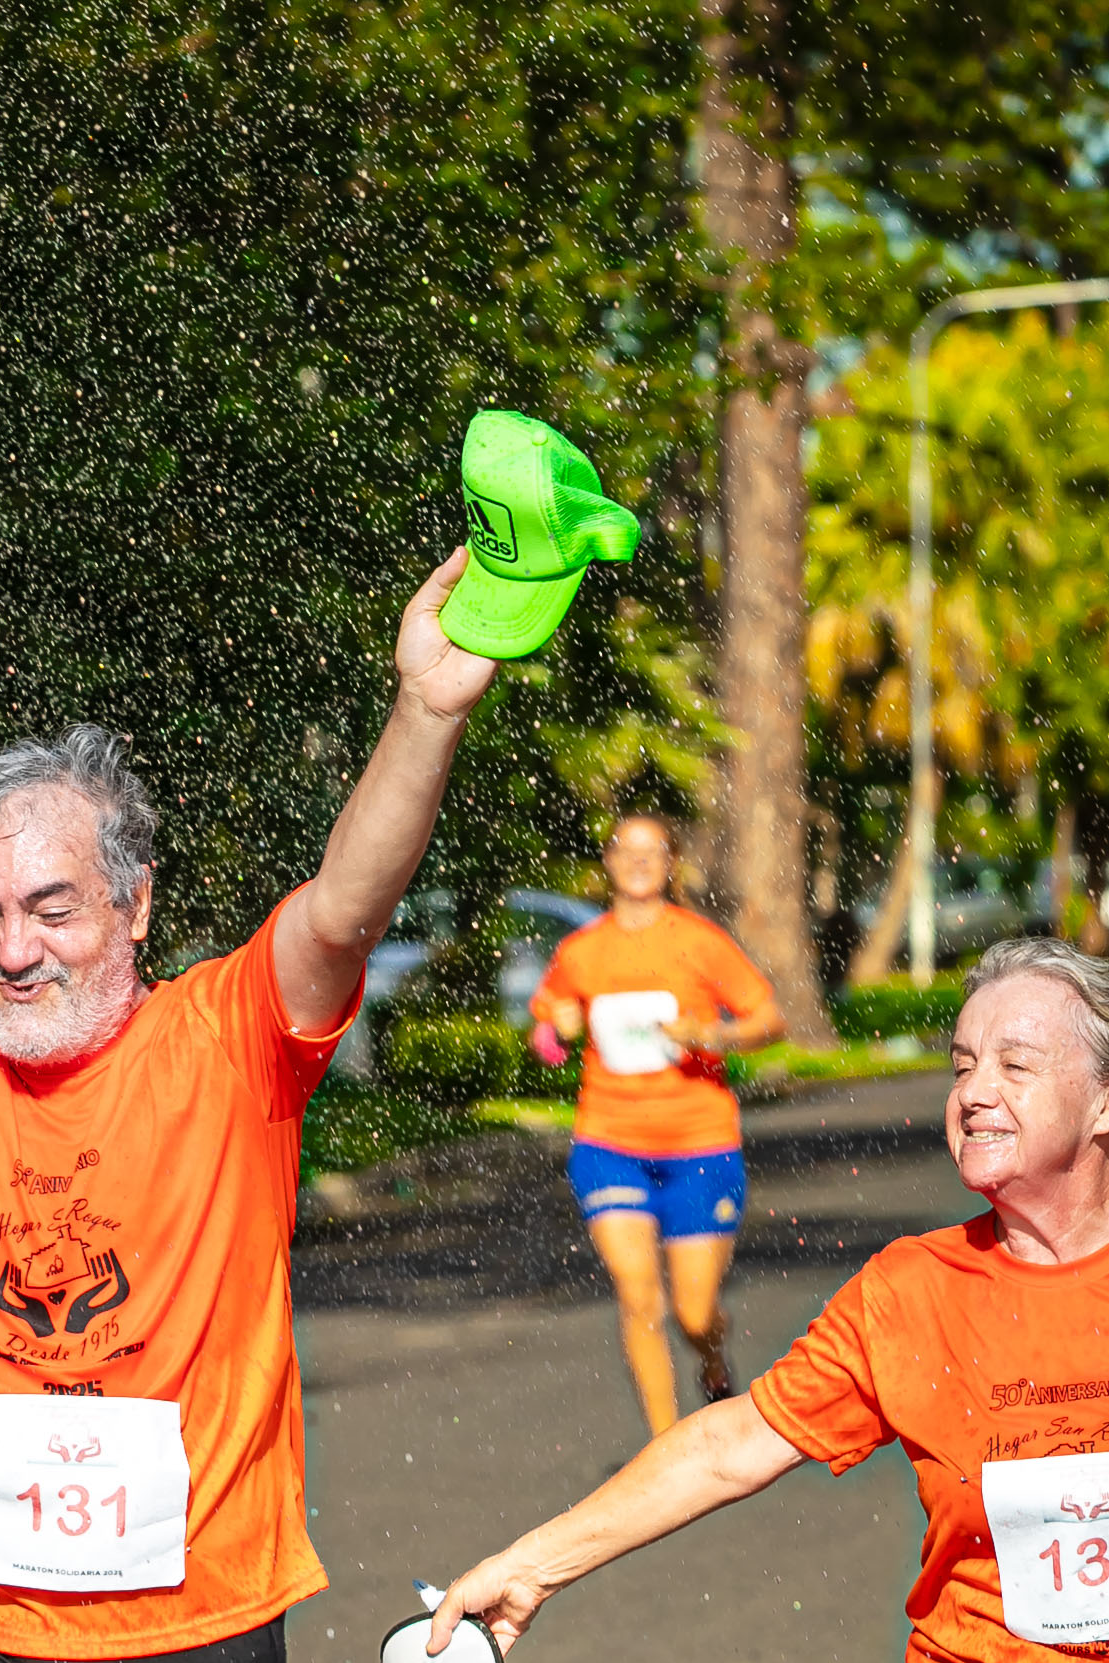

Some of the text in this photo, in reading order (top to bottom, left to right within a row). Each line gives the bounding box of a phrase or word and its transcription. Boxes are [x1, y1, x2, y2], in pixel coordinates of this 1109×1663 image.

[6, 1332, 69, 1361] Desde
[80, 1314, 119, 1357] 1975
[983, 1429, 1038, 1463] Hogar
[1044, 1416, 1085, 1437] San
[16, 1482, 127, 1538] 131
[12, 1563, 53, 1574] MARATON
[55, 1568, 101, 1577] SOLIDARIA
[1039, 1537, 1109, 1592] 13
[1042, 1622, 1083, 1630] MARATON
